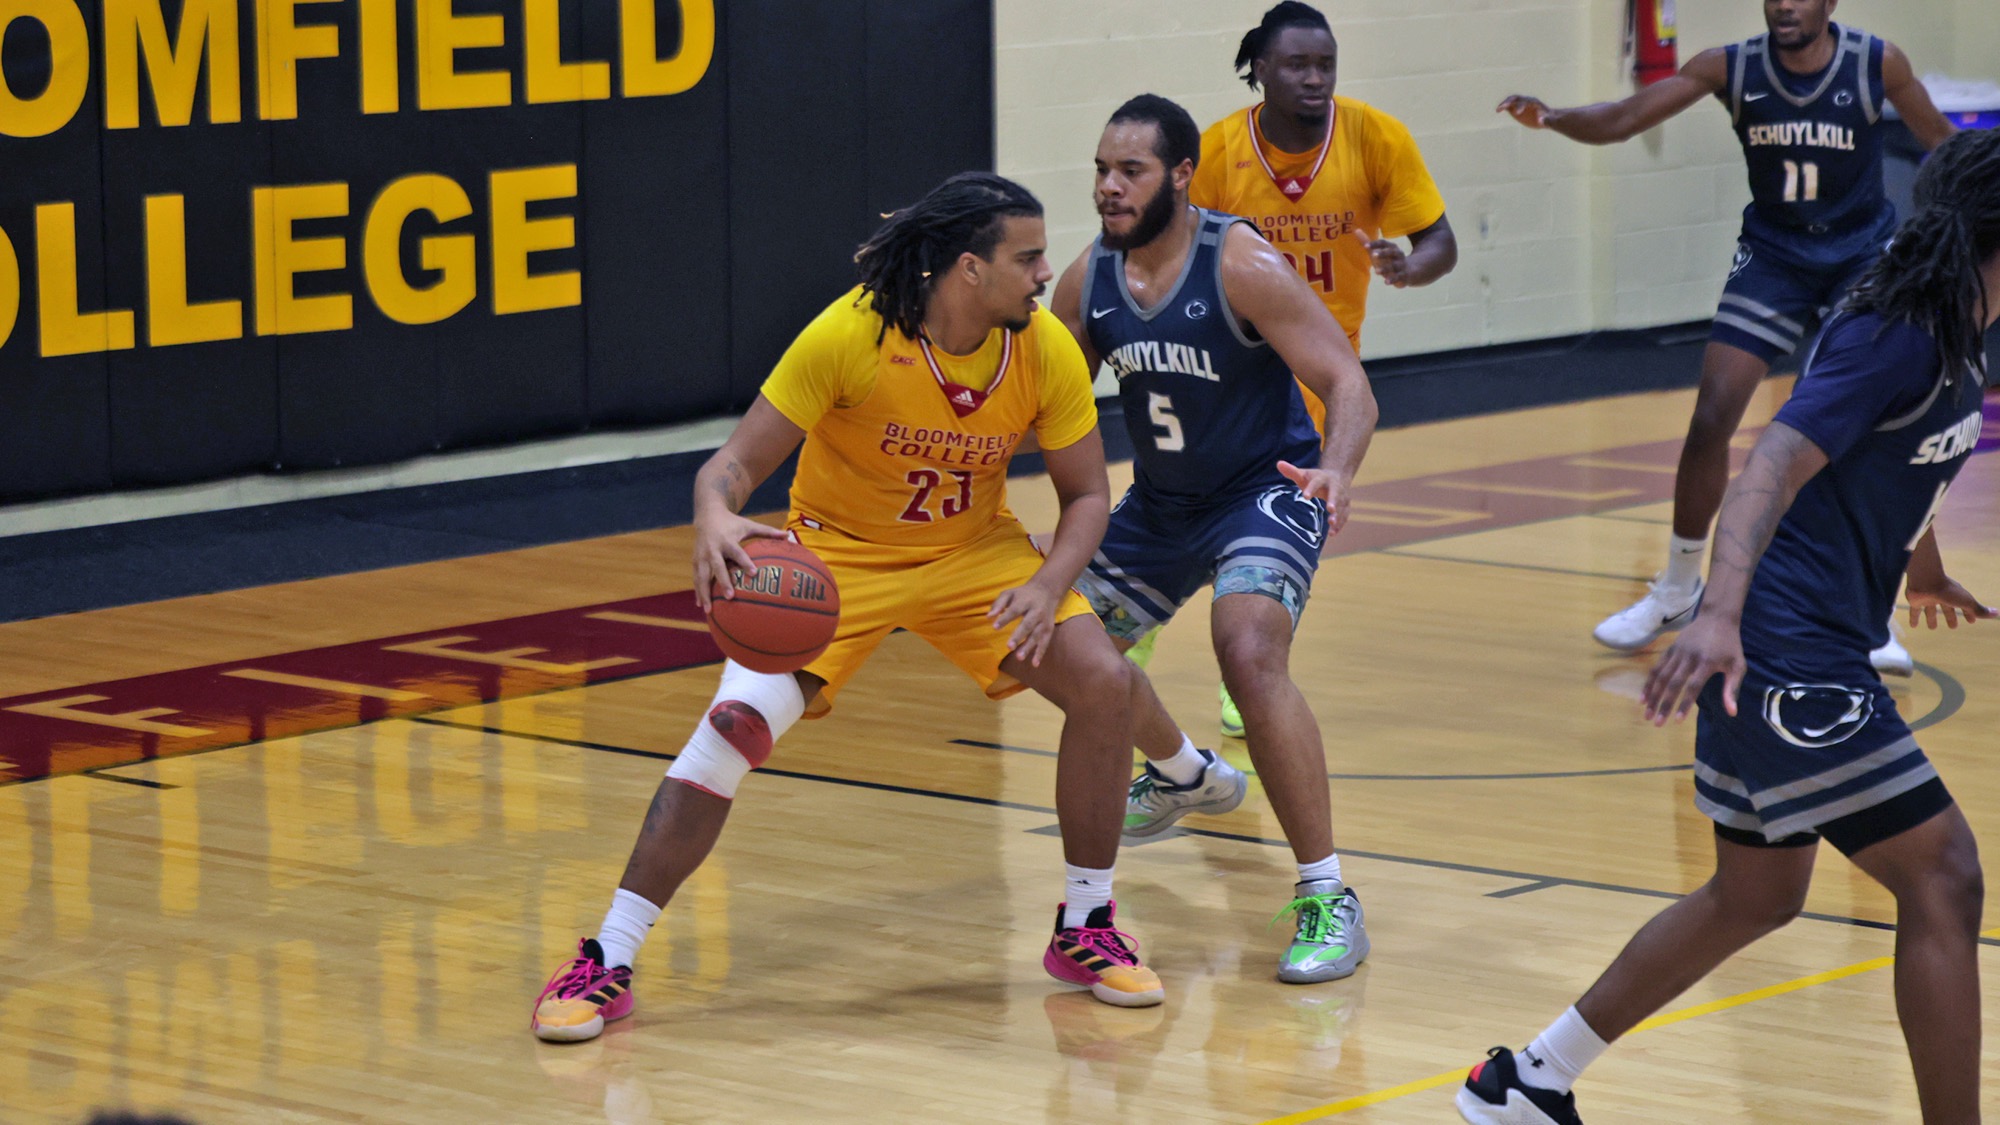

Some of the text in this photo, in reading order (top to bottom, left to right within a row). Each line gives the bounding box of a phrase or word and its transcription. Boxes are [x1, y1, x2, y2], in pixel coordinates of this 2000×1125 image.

[1749, 122, 1856, 151] SCHUYLKILL
[1783, 160, 1819, 202] 11
[1262, 222, 1353, 243] OLLEGE
[0, 164, 582, 358] LLEGE
[1148, 391, 1185, 453] 5
[790, 569, 827, 602] THE
